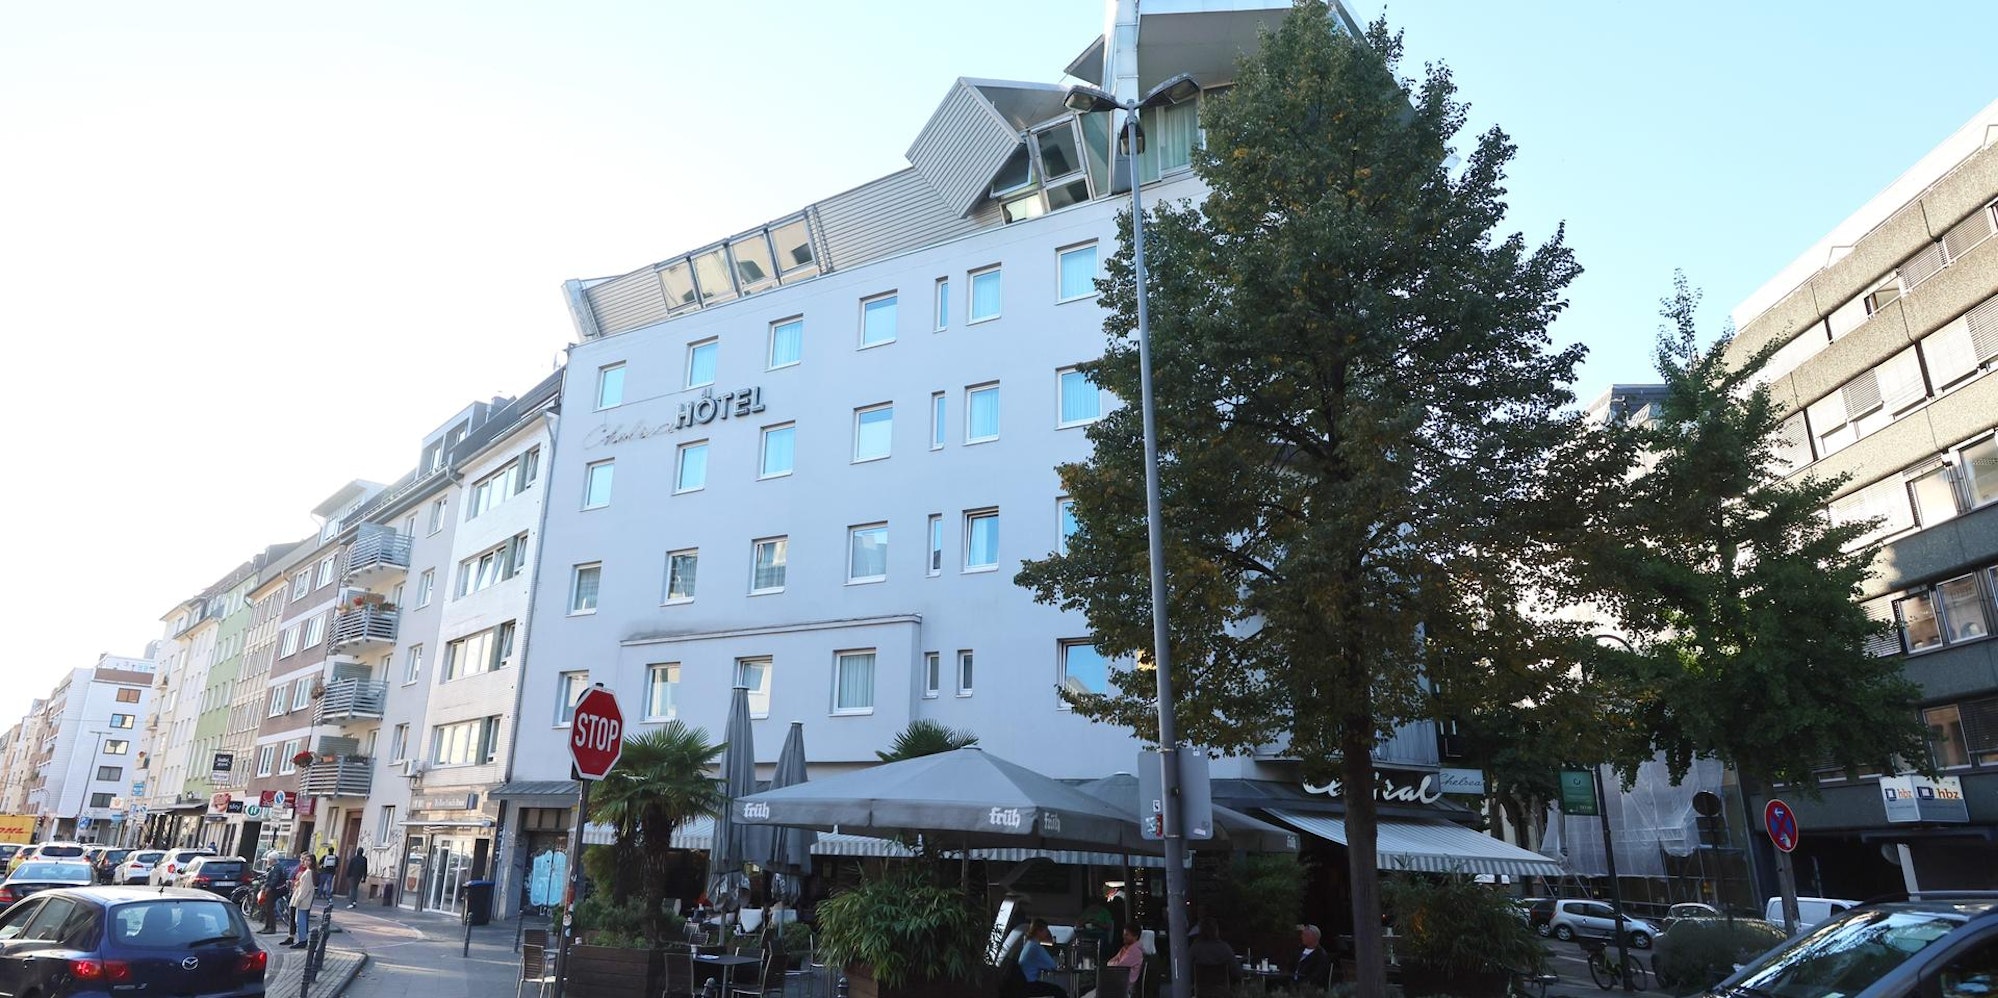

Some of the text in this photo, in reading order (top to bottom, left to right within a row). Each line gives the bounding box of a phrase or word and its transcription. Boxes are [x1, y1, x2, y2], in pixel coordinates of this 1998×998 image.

[575, 712, 619, 752] STOP
[1440, 772, 1482, 787] Chelsea
[1897, 787, 1912, 798] hbz
[1936, 787, 1958, 799] hbz
[743, 801, 770, 820] früh
[988, 806, 1021, 829] früh
